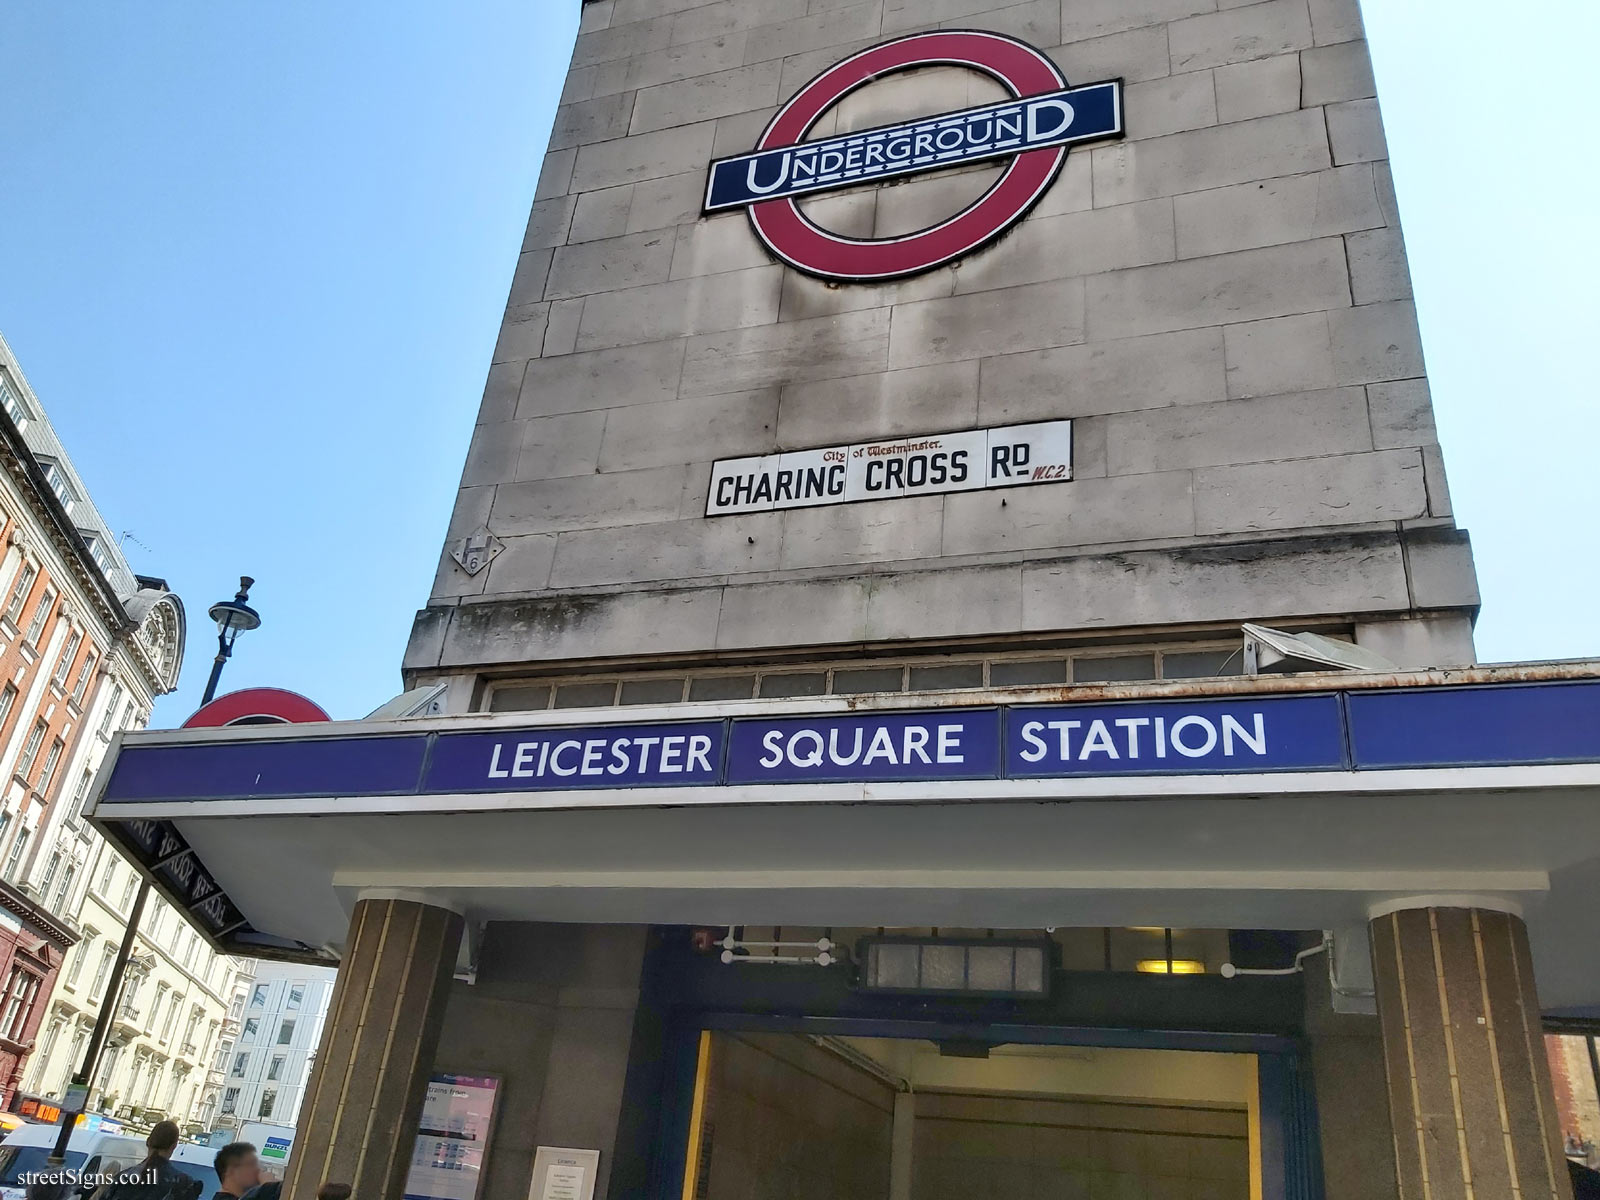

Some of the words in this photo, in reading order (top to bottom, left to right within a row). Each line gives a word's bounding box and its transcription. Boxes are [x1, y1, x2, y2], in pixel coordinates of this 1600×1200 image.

[747, 99, 1075, 194] UNDERGROUND
[823, 451, 846, 463] City
[853, 448, 864, 458] of
[716, 464, 845, 507] CHARING
[865, 450, 969, 492] CROSS
[462, 536, 493, 564] H
[470, 557, 479, 570] 6
[487, 735, 713, 779] LEICESTER
[759, 724, 965, 769] SQUARE
[1019, 713, 1267, 762] STATION
[264, 1143, 288, 1151] BUNZL
